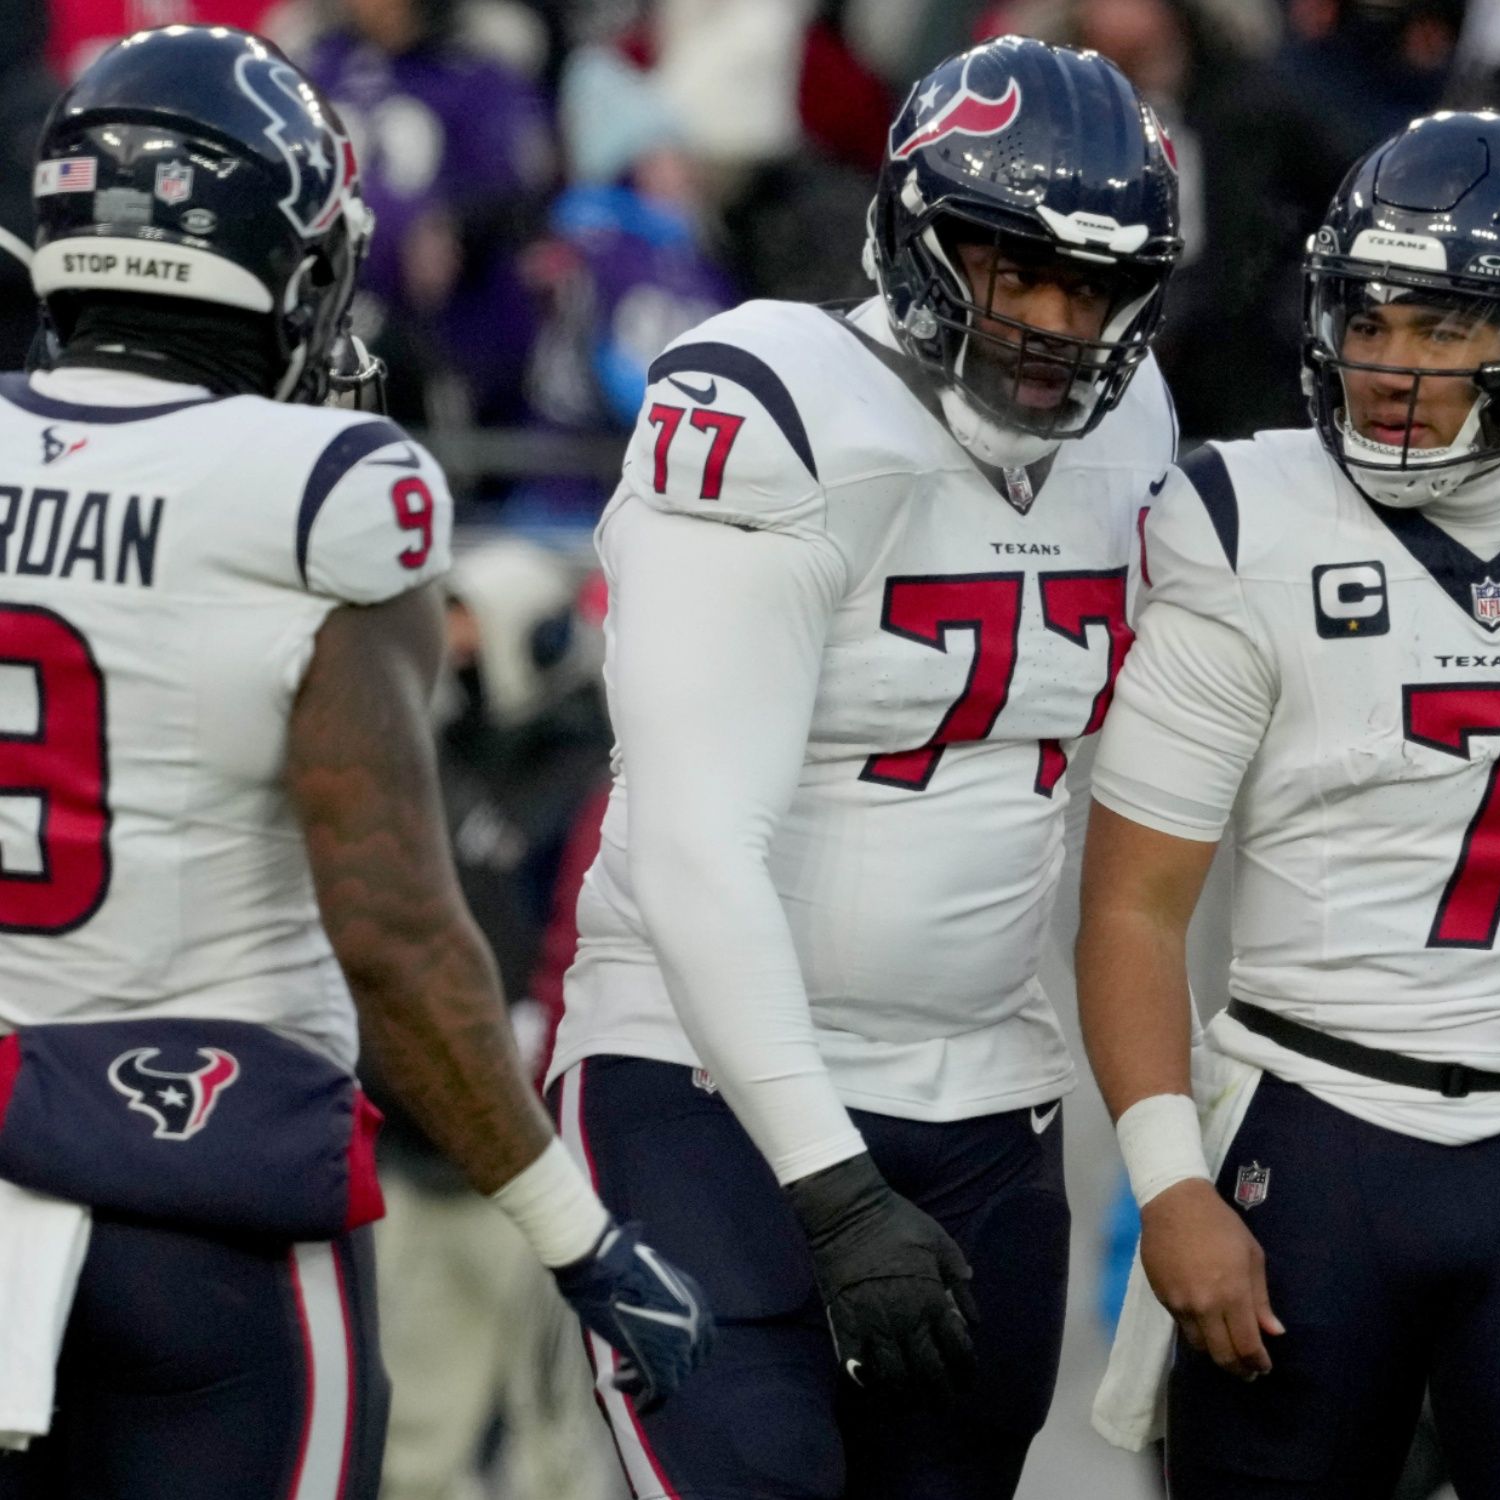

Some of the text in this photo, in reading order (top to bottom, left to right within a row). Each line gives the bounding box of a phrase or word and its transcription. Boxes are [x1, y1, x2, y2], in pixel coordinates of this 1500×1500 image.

[63, 253, 191, 282] STOP HATE
[1367, 235, 1428, 251] TEXANS
[648, 402, 746, 501] 77
[390, 476, 433, 569] 9
[990, 542, 1061, 556] TEXANS
[1319, 566, 1383, 619] C
[857, 564, 1137, 799] 77
